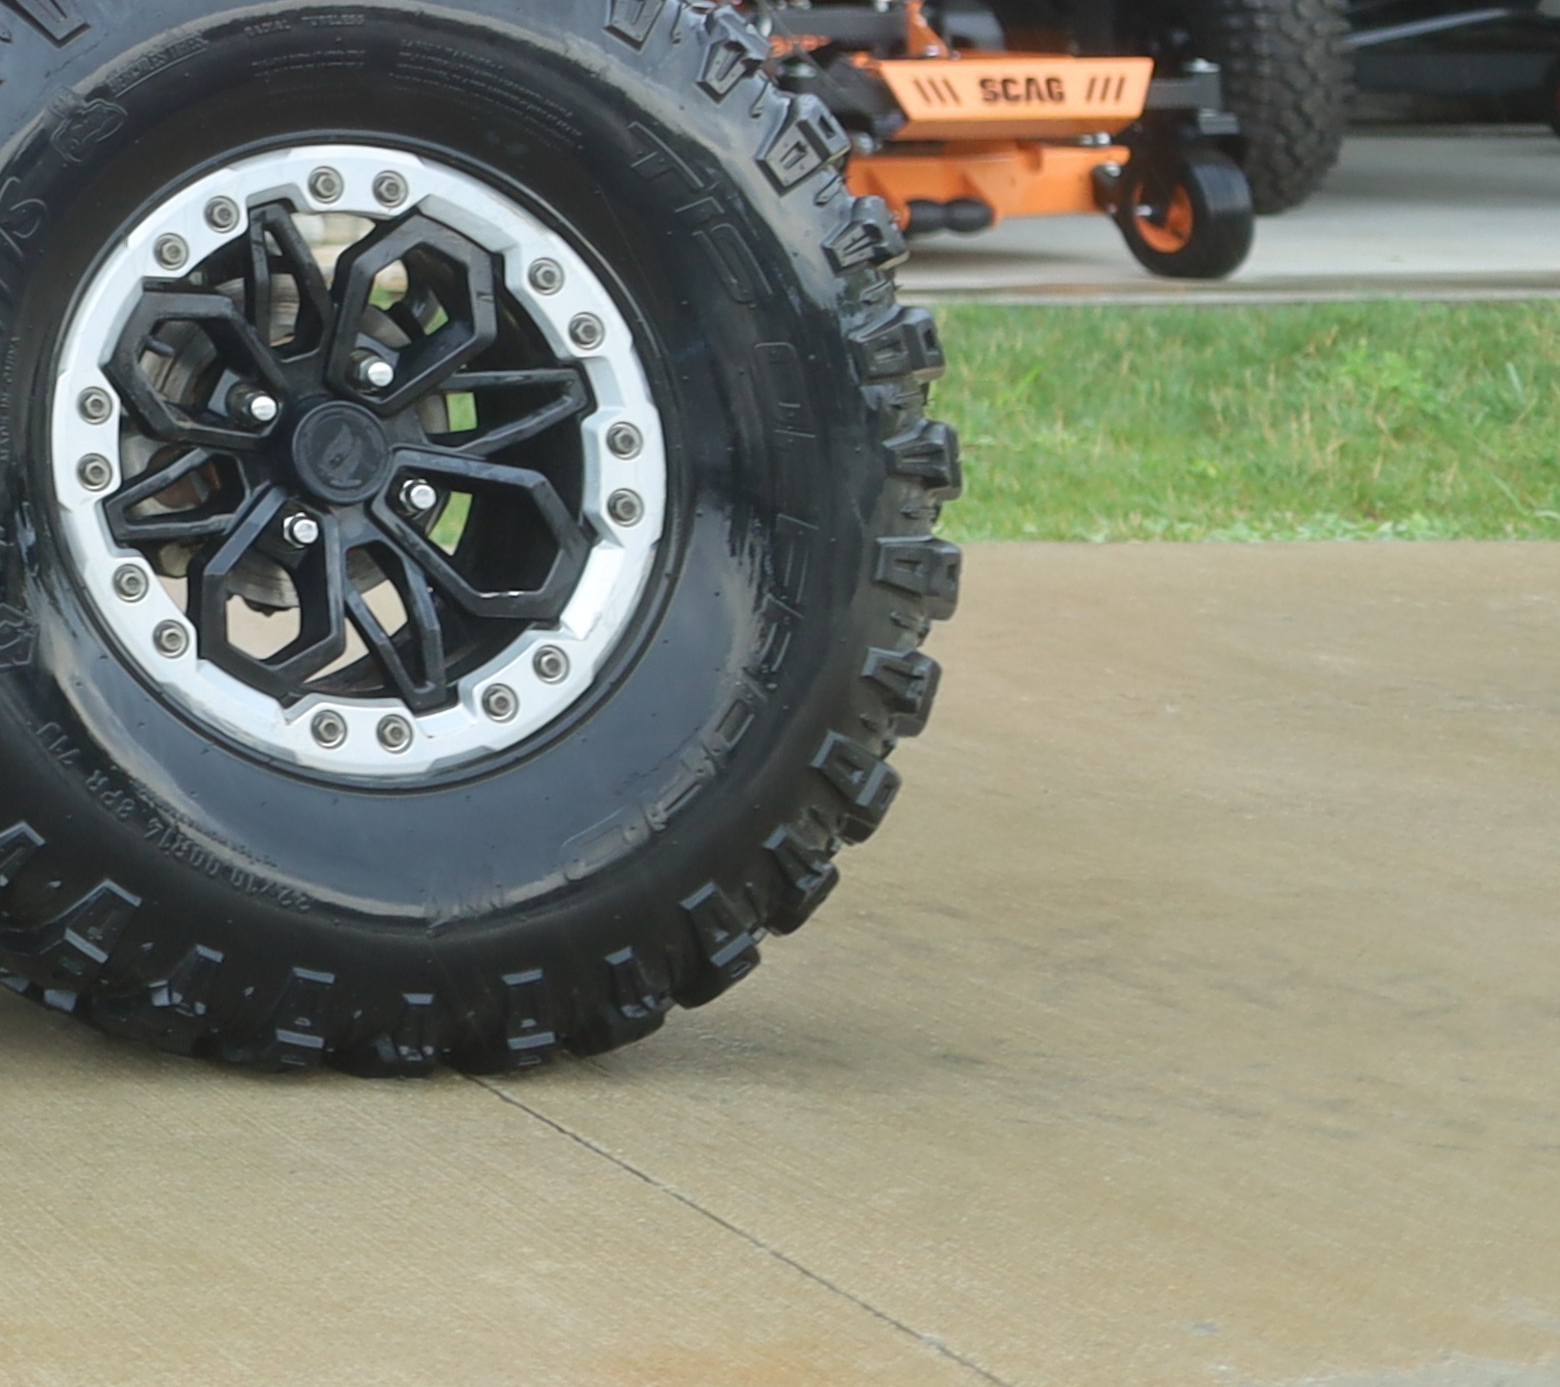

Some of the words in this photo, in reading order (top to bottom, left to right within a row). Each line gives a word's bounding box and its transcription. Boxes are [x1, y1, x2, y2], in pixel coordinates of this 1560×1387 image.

[978, 77, 1065, 104] SCAG
[36, 721, 81, 765] 71J
[87, 770, 135, 819] 8PR
